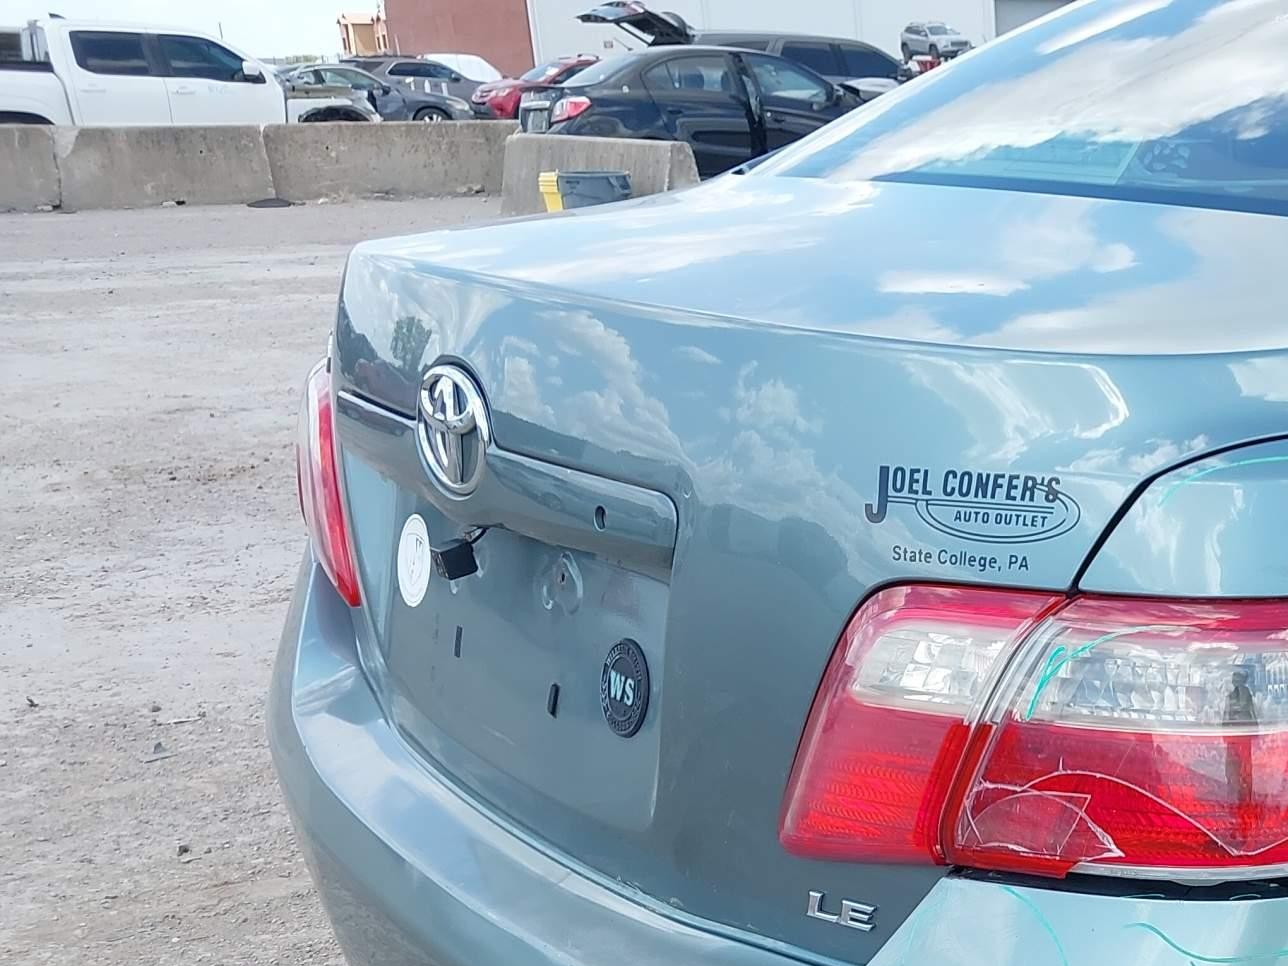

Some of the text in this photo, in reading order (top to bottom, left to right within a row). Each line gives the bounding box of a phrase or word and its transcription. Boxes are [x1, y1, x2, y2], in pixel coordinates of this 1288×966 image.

[864, 465, 1061, 524] JOEL CONFER'S
[953, 509, 1049, 529] AUTO OUTLET
[892, 545, 1029, 572] State College, PA
[610, 669, 635, 707] WS
[807, 890, 877, 932] LE
